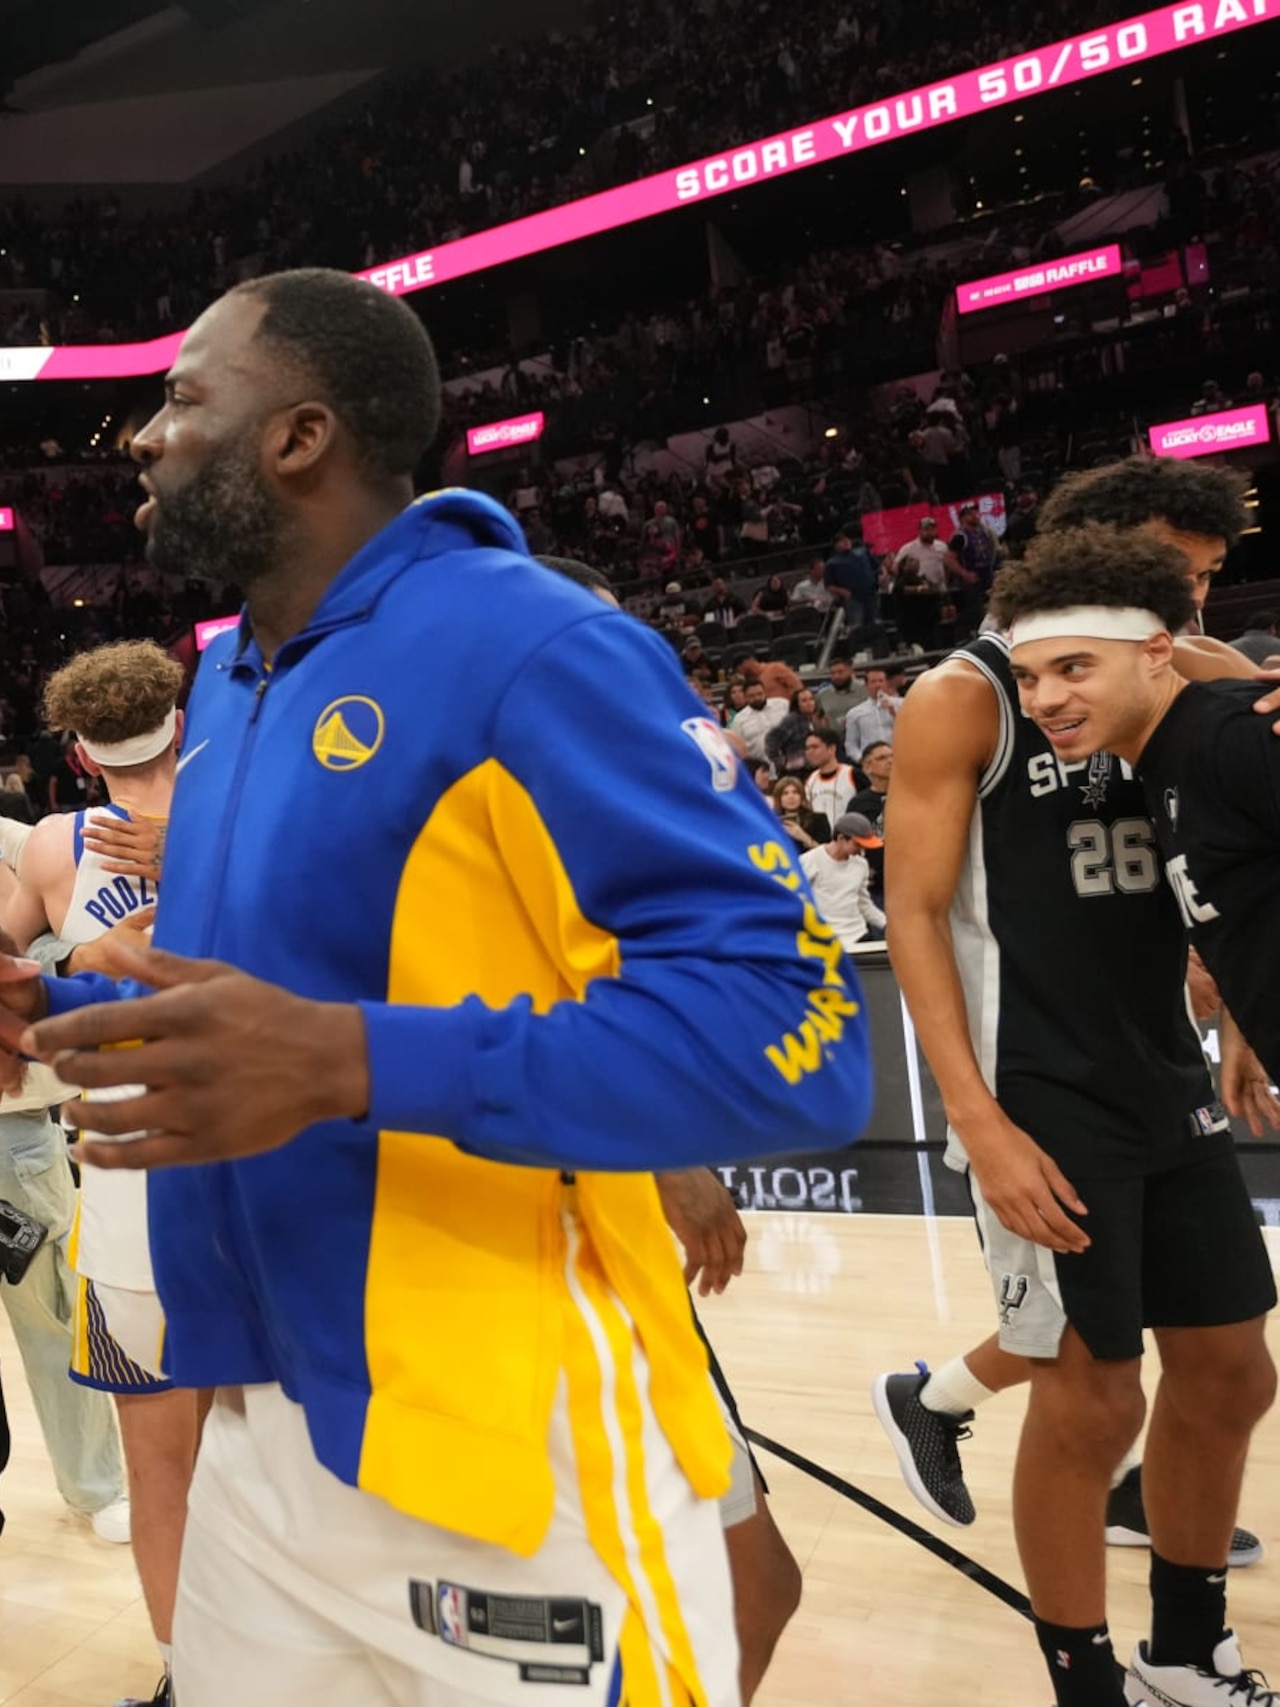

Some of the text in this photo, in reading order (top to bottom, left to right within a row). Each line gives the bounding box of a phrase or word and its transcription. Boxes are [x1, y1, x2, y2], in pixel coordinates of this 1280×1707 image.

[675, 131, 816, 199] SCORE
[832, 85, 957, 148] YOUR
[978, 23, 1147, 103] 50/50
[358, 254, 435, 291] FFLE
[1046, 255, 1107, 283] RAFFLE
[1162, 431, 1198, 448] LUCKY
[1216, 420, 1255, 437] EAGLE
[1066, 817, 1159, 898] 26
